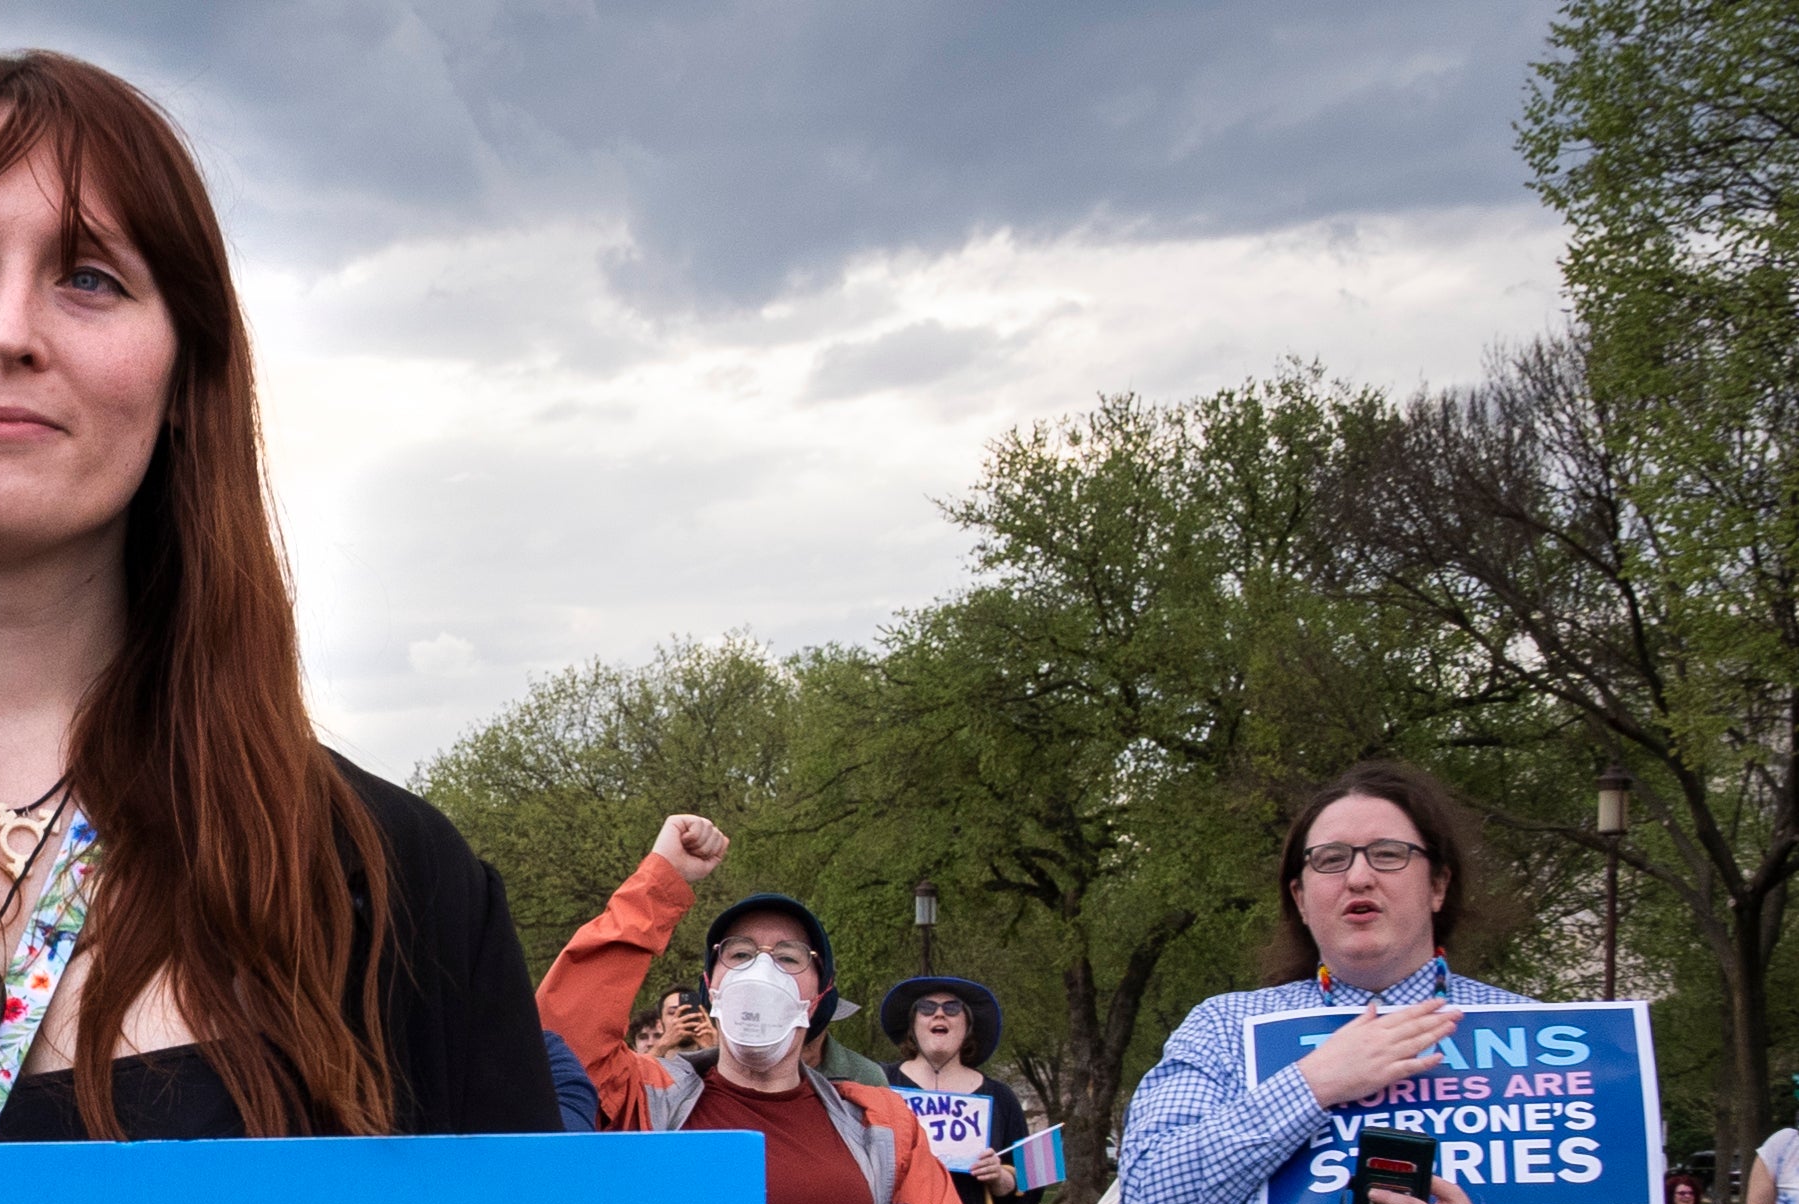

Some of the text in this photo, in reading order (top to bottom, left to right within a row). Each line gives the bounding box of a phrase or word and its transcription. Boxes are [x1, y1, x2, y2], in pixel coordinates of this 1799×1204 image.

[741, 1011, 761, 1022] 3M
[1300, 1024, 1592, 1071] ANS
[904, 1096, 968, 1118] RANS
[1337, 1072, 1595, 1107] ORIES ARE
[929, 1110, 982, 1142] JOY
[1310, 1101, 1597, 1149] EVERYONE'S
[1308, 1136, 1603, 1194] SRIES
